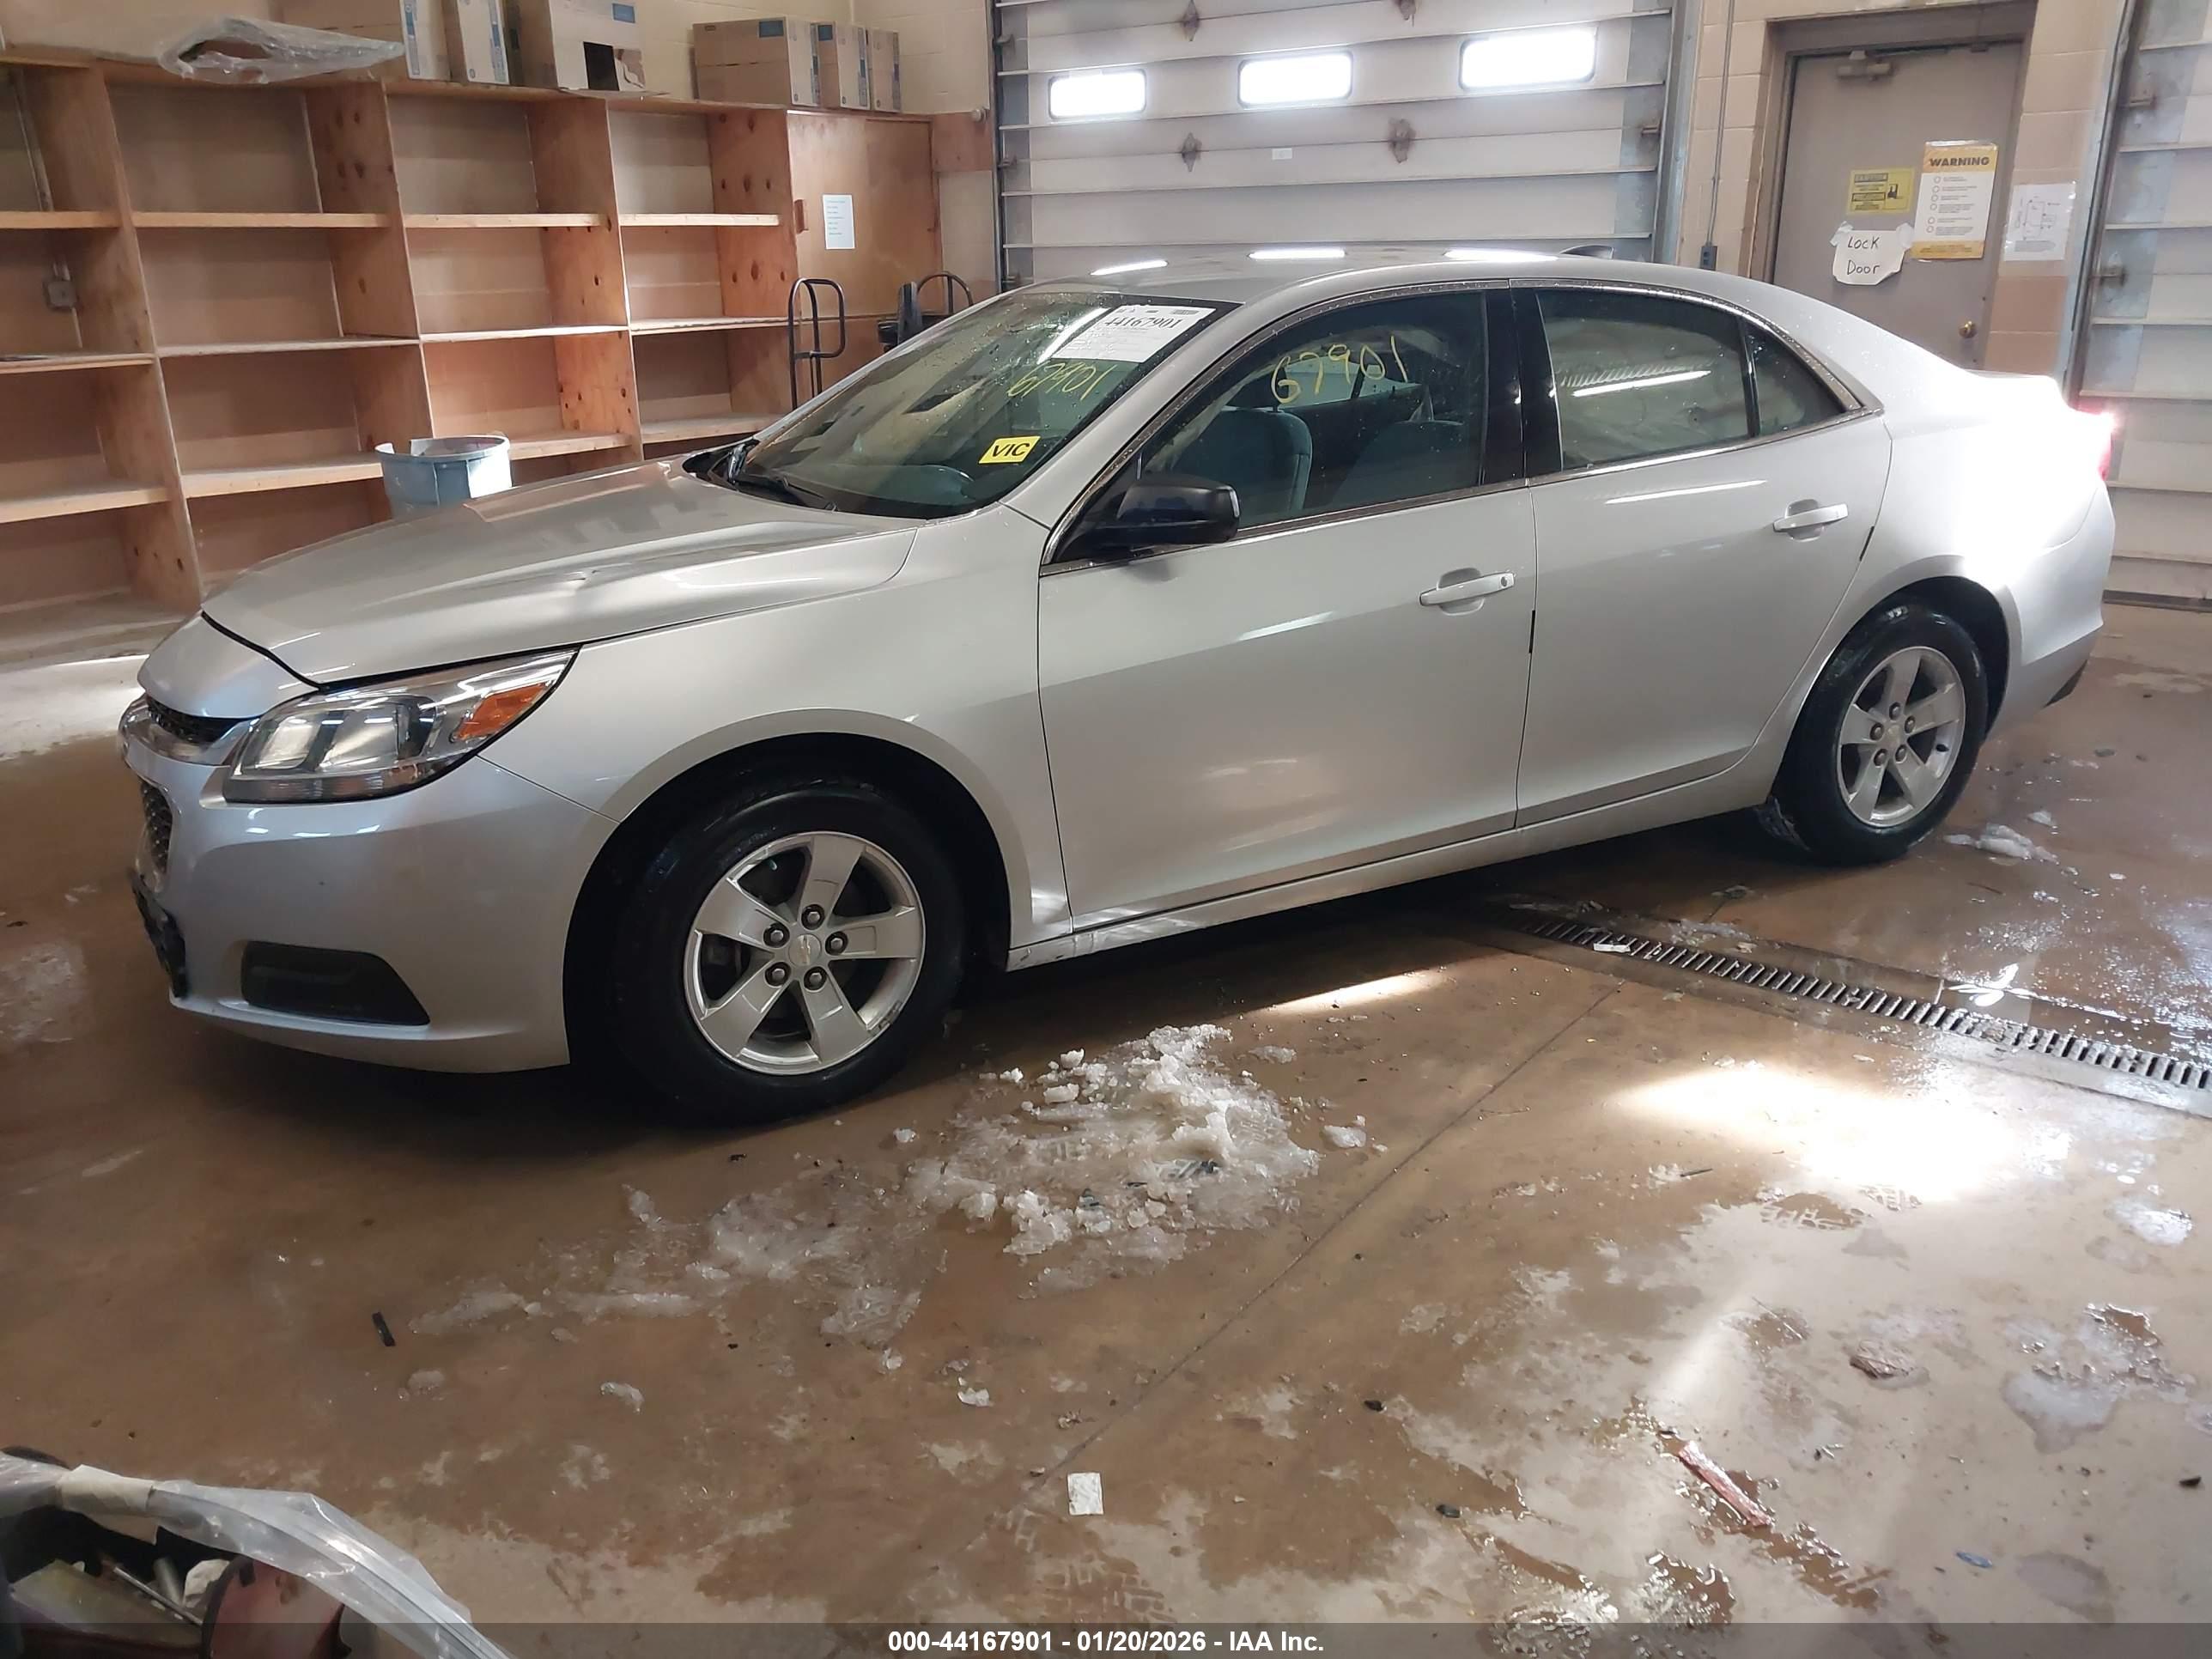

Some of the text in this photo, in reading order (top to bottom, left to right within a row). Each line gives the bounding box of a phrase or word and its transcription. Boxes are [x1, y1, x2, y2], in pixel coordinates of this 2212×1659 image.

[1929, 156, 1990, 167] WARNING
[1847, 259, 1881, 276] Door
[1104, 316, 1183, 329] 44167901
[1270, 334, 1408, 404] 67901
[1006, 360, 1117, 401] 67901
[991, 442, 1030, 458] VIC
